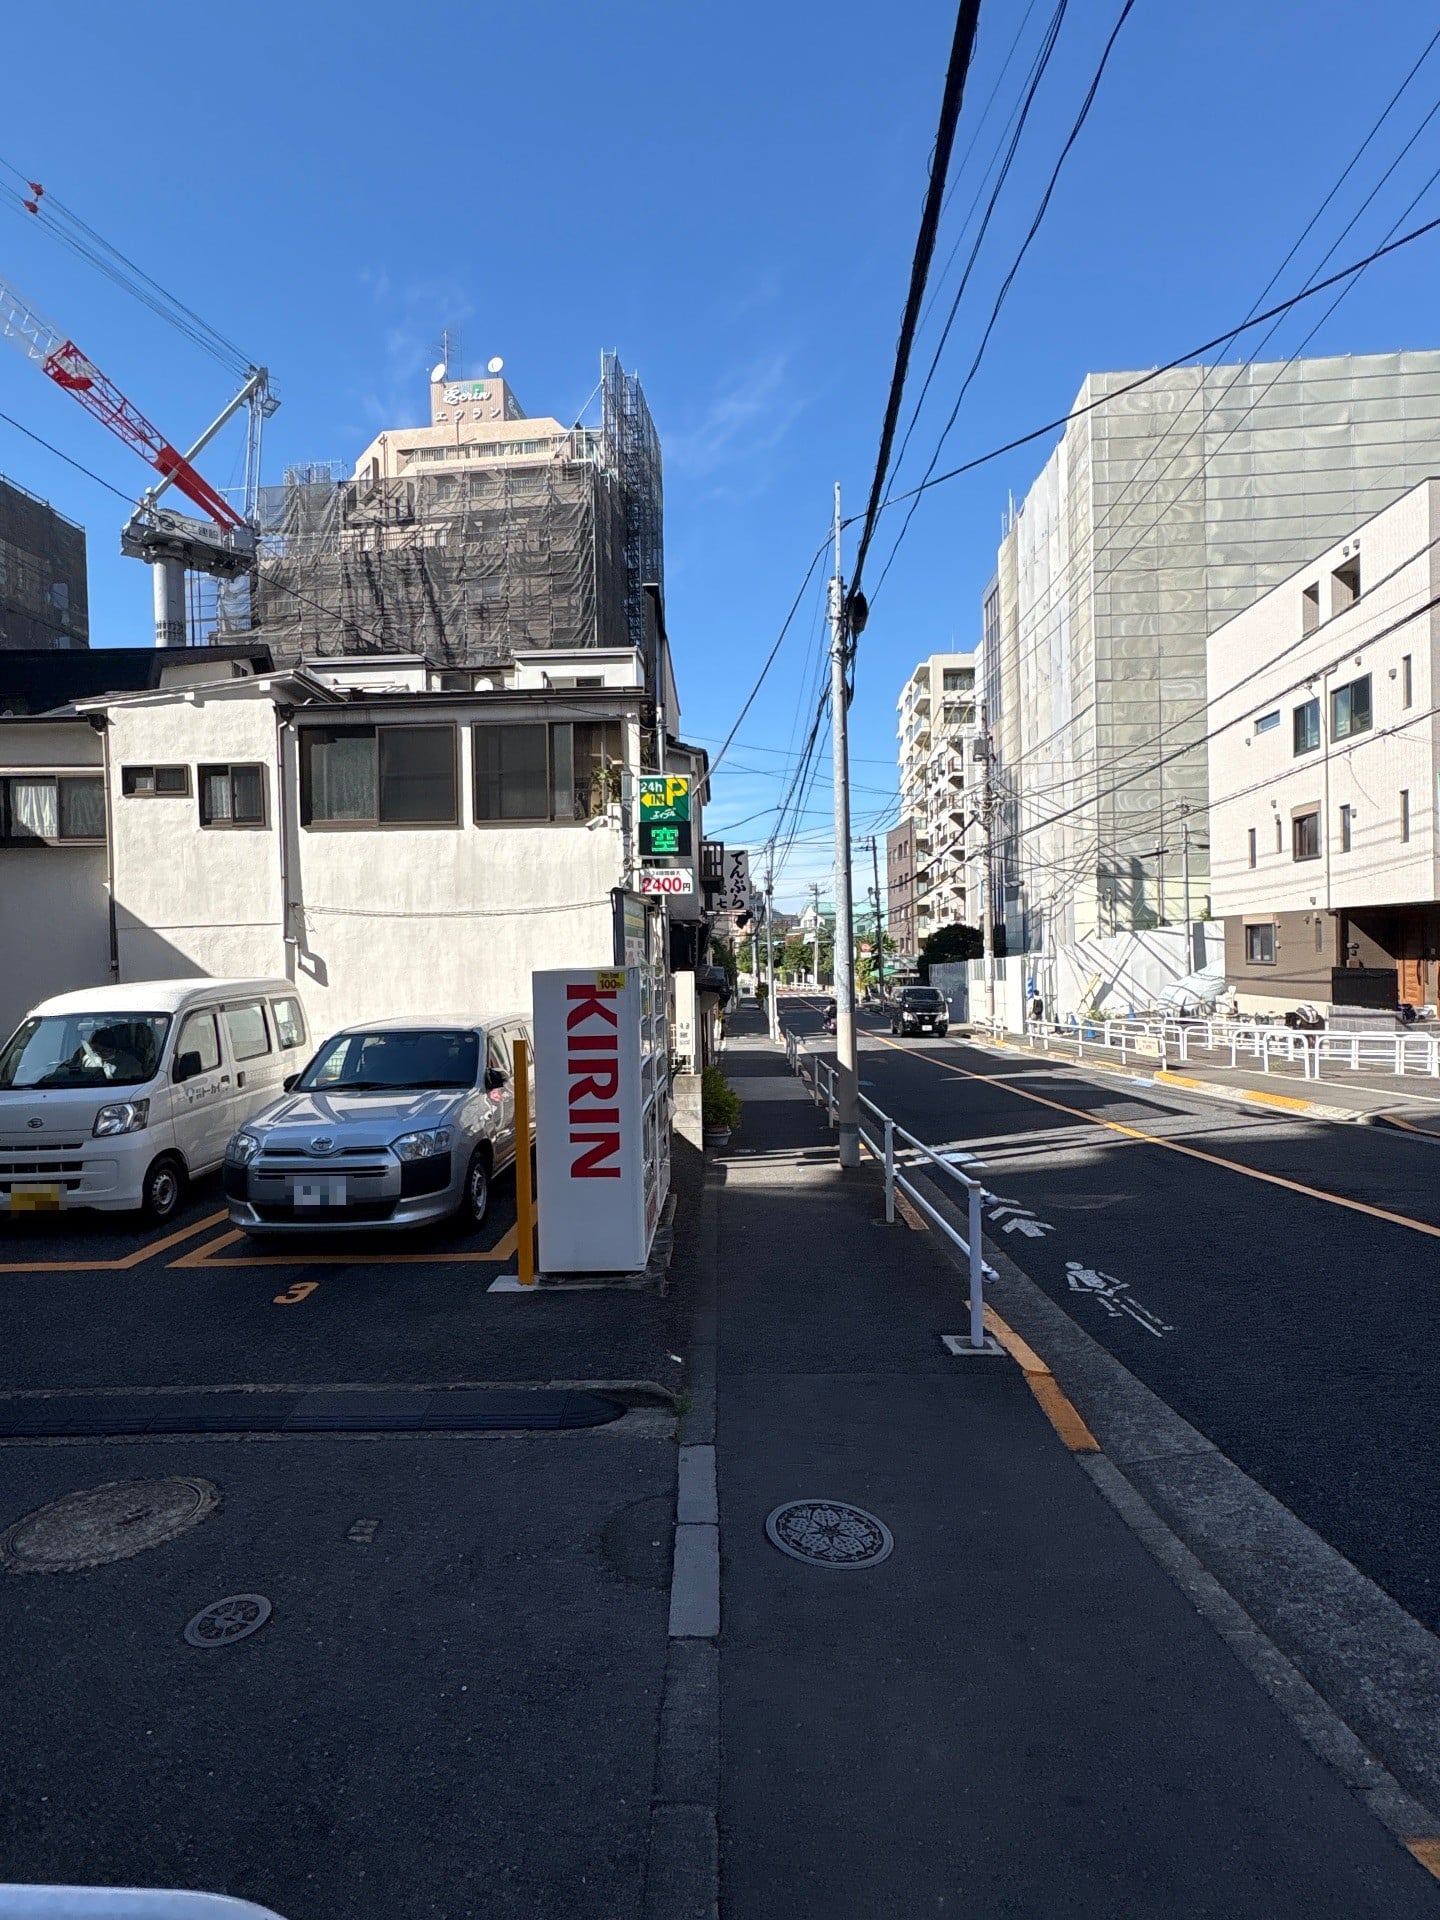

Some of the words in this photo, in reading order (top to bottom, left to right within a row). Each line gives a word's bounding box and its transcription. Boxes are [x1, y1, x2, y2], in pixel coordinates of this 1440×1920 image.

[435, 408, 501, 422] エクラン
[640, 781, 663, 793] 24h
[666, 778, 688, 807] P
[651, 794, 664, 805] IN
[651, 827, 679, 852] 空
[566, 984, 621, 1178] KIRIN
[273, 1281, 320, 1304] 3
